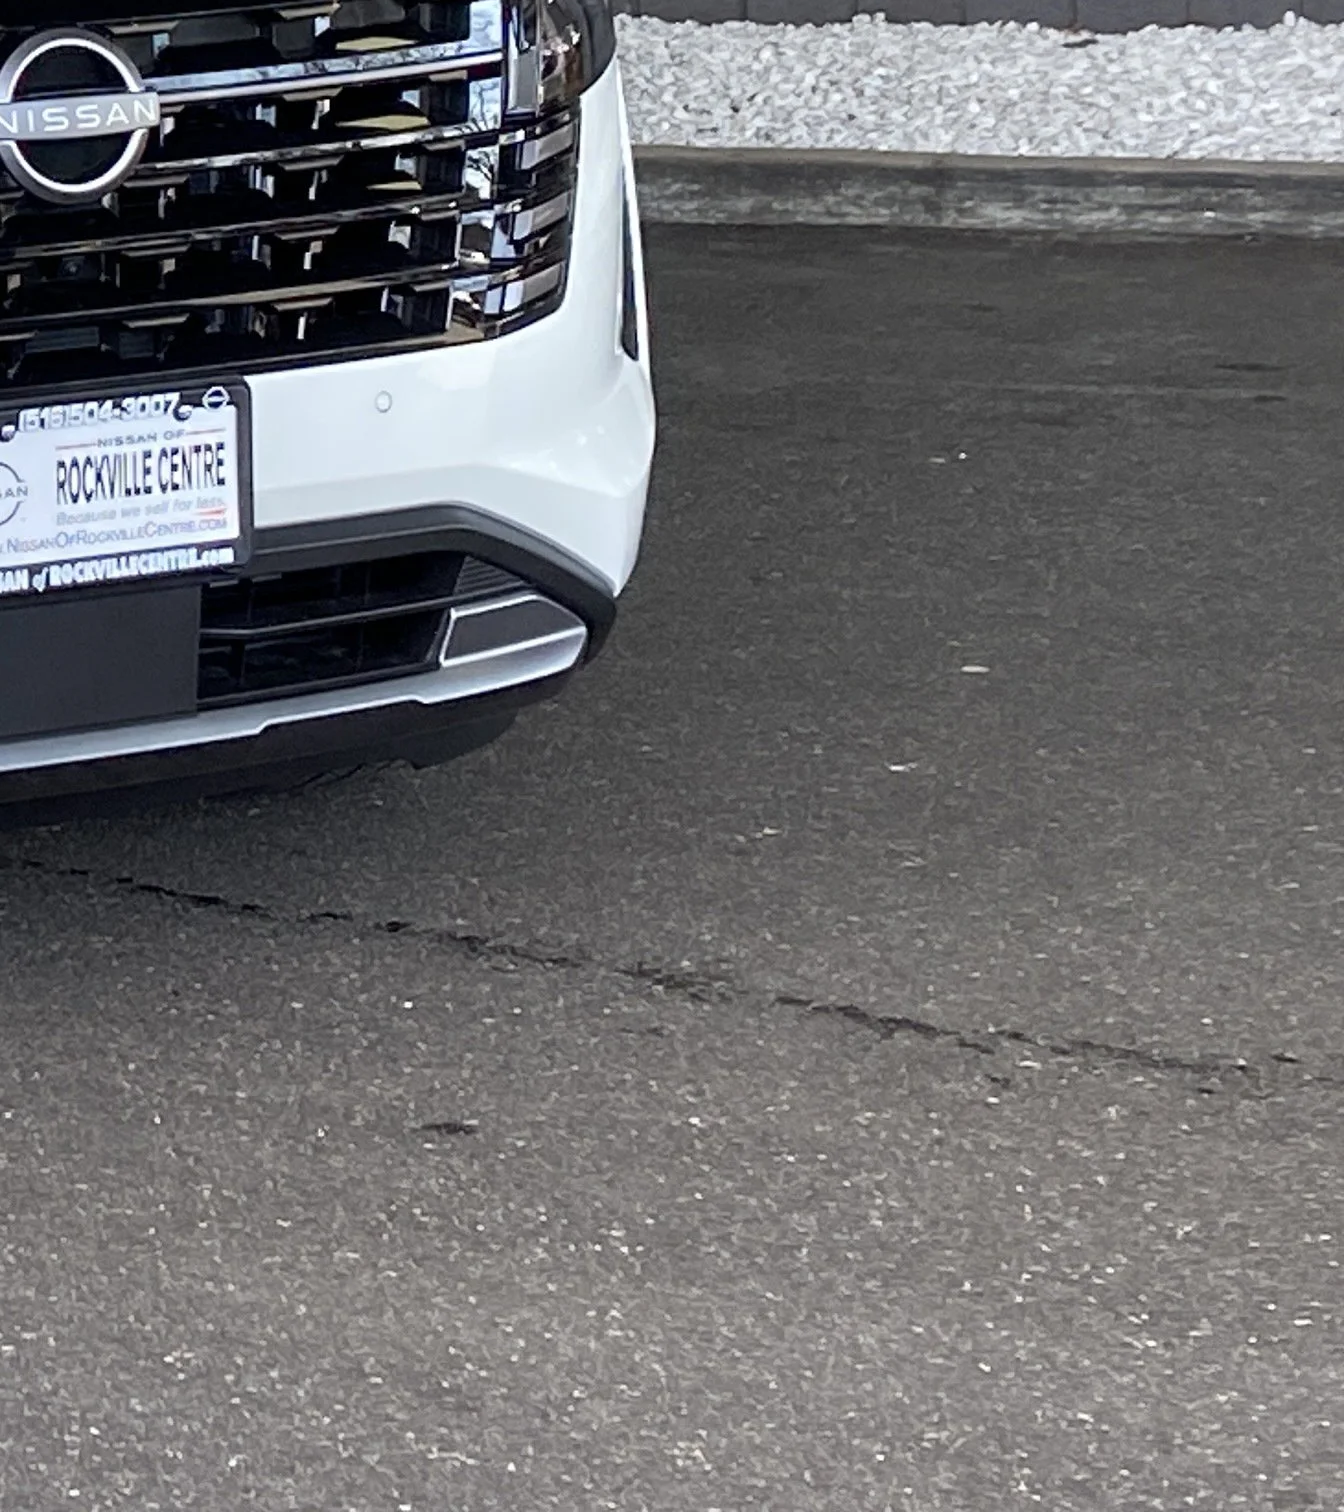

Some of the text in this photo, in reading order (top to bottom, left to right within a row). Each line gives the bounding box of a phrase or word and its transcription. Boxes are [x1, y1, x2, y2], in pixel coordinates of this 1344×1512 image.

[97, 429, 187, 448] NISSAN OF
[56, 441, 226, 505] ROCKVILLE CENTRE
[56, 509, 117, 526] Because
[121, 506, 141, 518] we
[145, 500, 171, 516] sell
[173, 498, 193, 513] for
[32, 567, 49, 593] of
